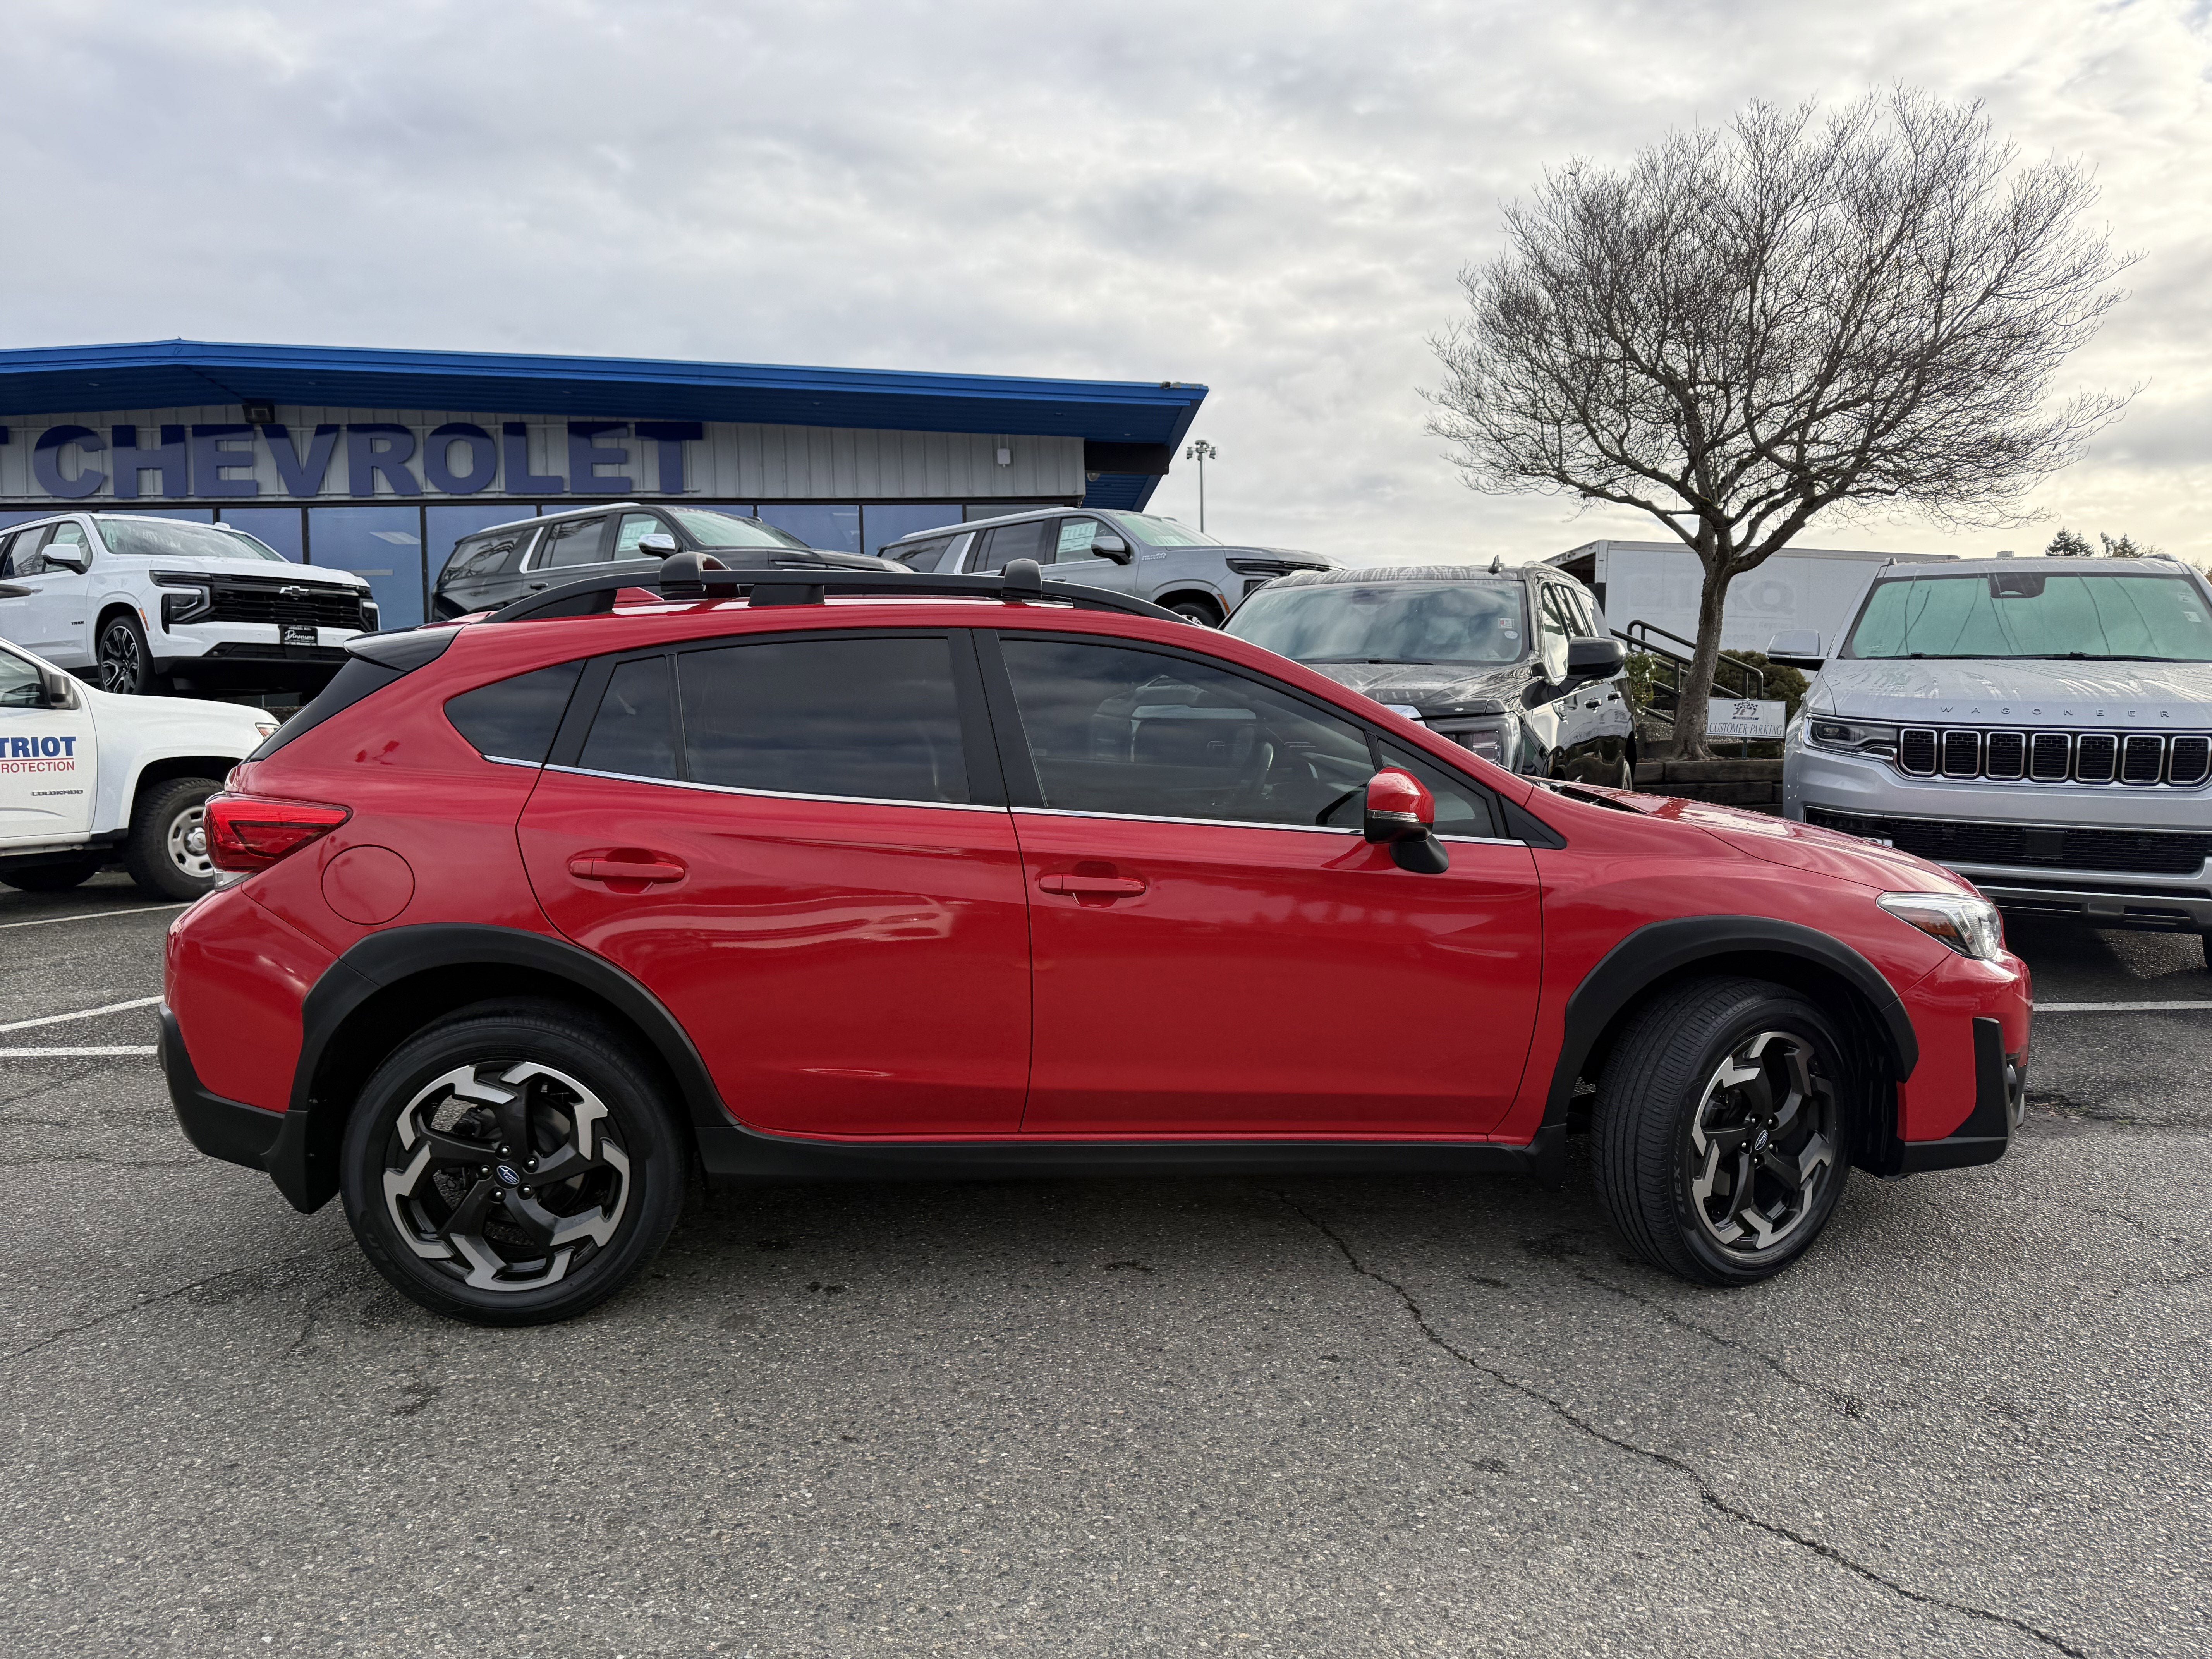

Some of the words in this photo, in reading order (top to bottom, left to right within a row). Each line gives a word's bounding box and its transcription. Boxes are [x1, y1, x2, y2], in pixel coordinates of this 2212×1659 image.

[33, 422, 702, 498] CHEVROLET
[1941, 706, 2169, 718] WAGONEER
[1709, 722, 1747, 734] CUSTOMER
[1746, 724, 1783, 735] PARKING
[1, 761, 74, 773] ROTECTION
